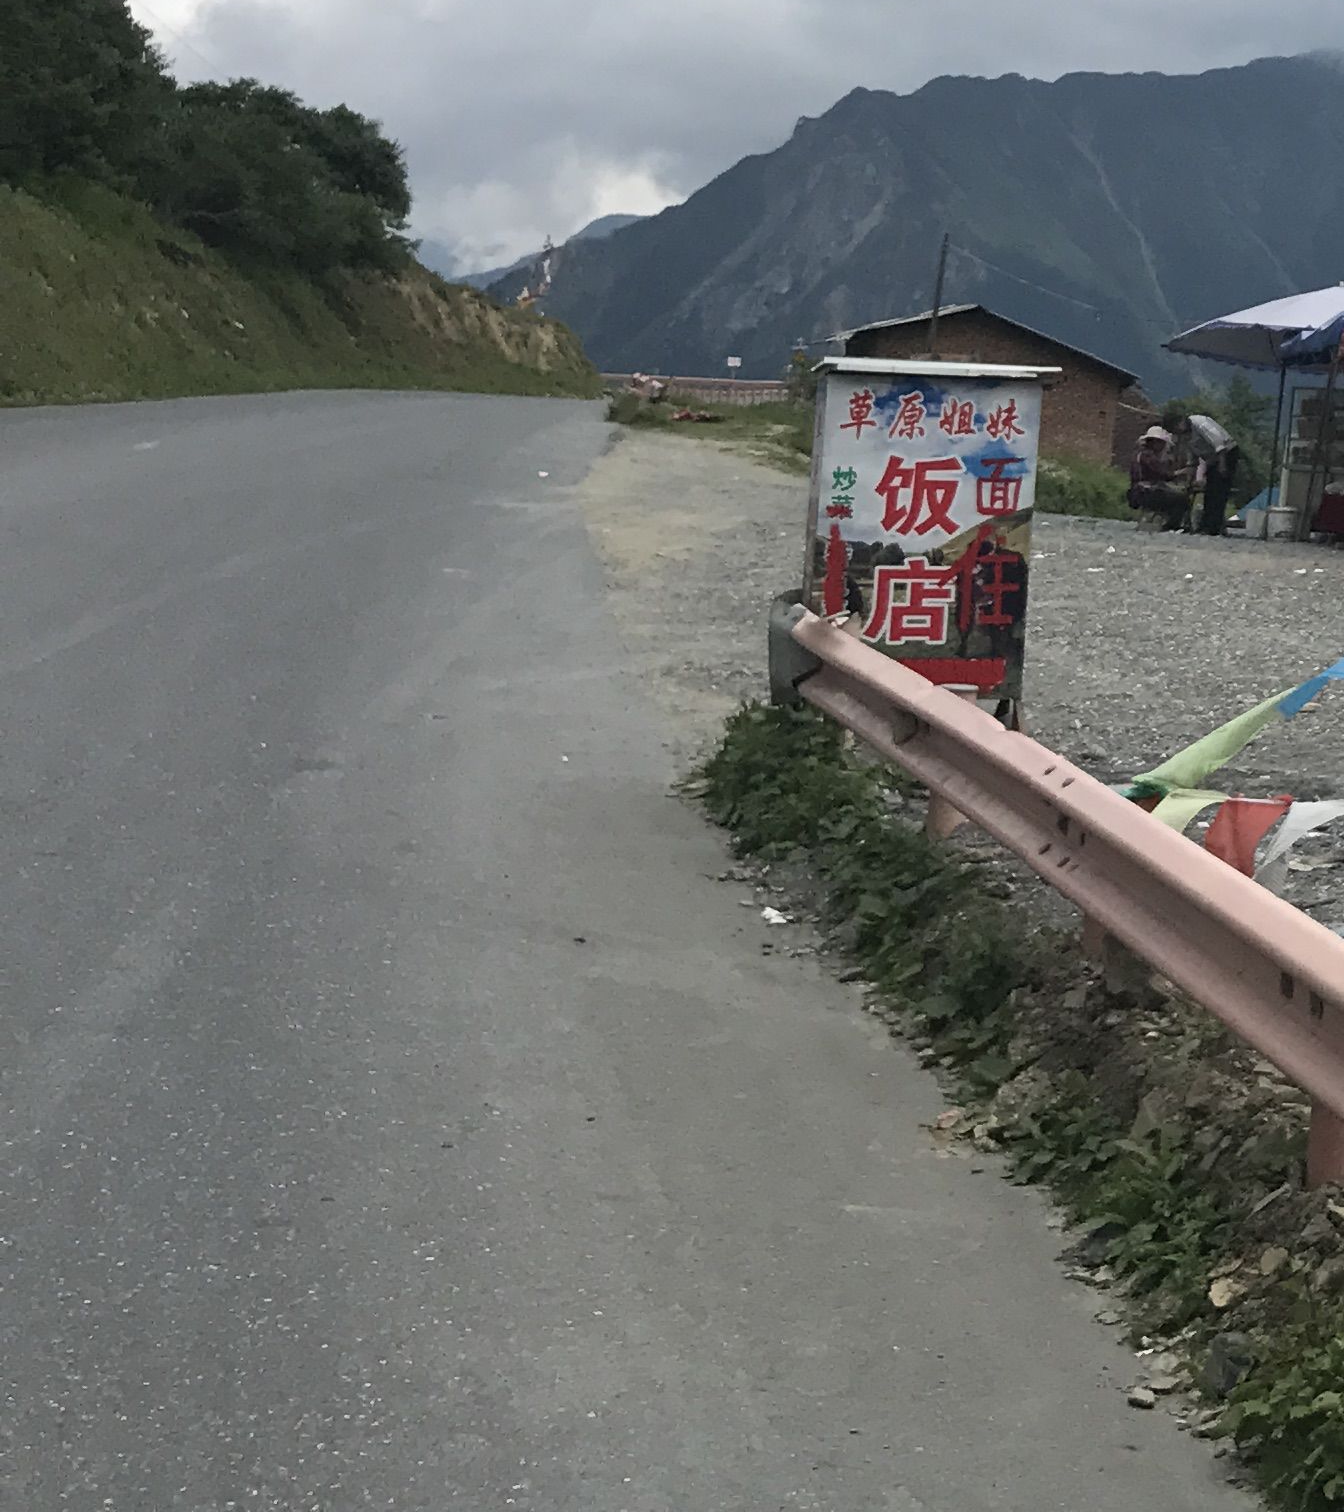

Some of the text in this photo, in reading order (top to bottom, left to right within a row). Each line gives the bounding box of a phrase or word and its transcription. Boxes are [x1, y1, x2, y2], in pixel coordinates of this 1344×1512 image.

[840, 389, 1025, 440] 草原姐妹
[863, 455, 966, 644] 饭店
